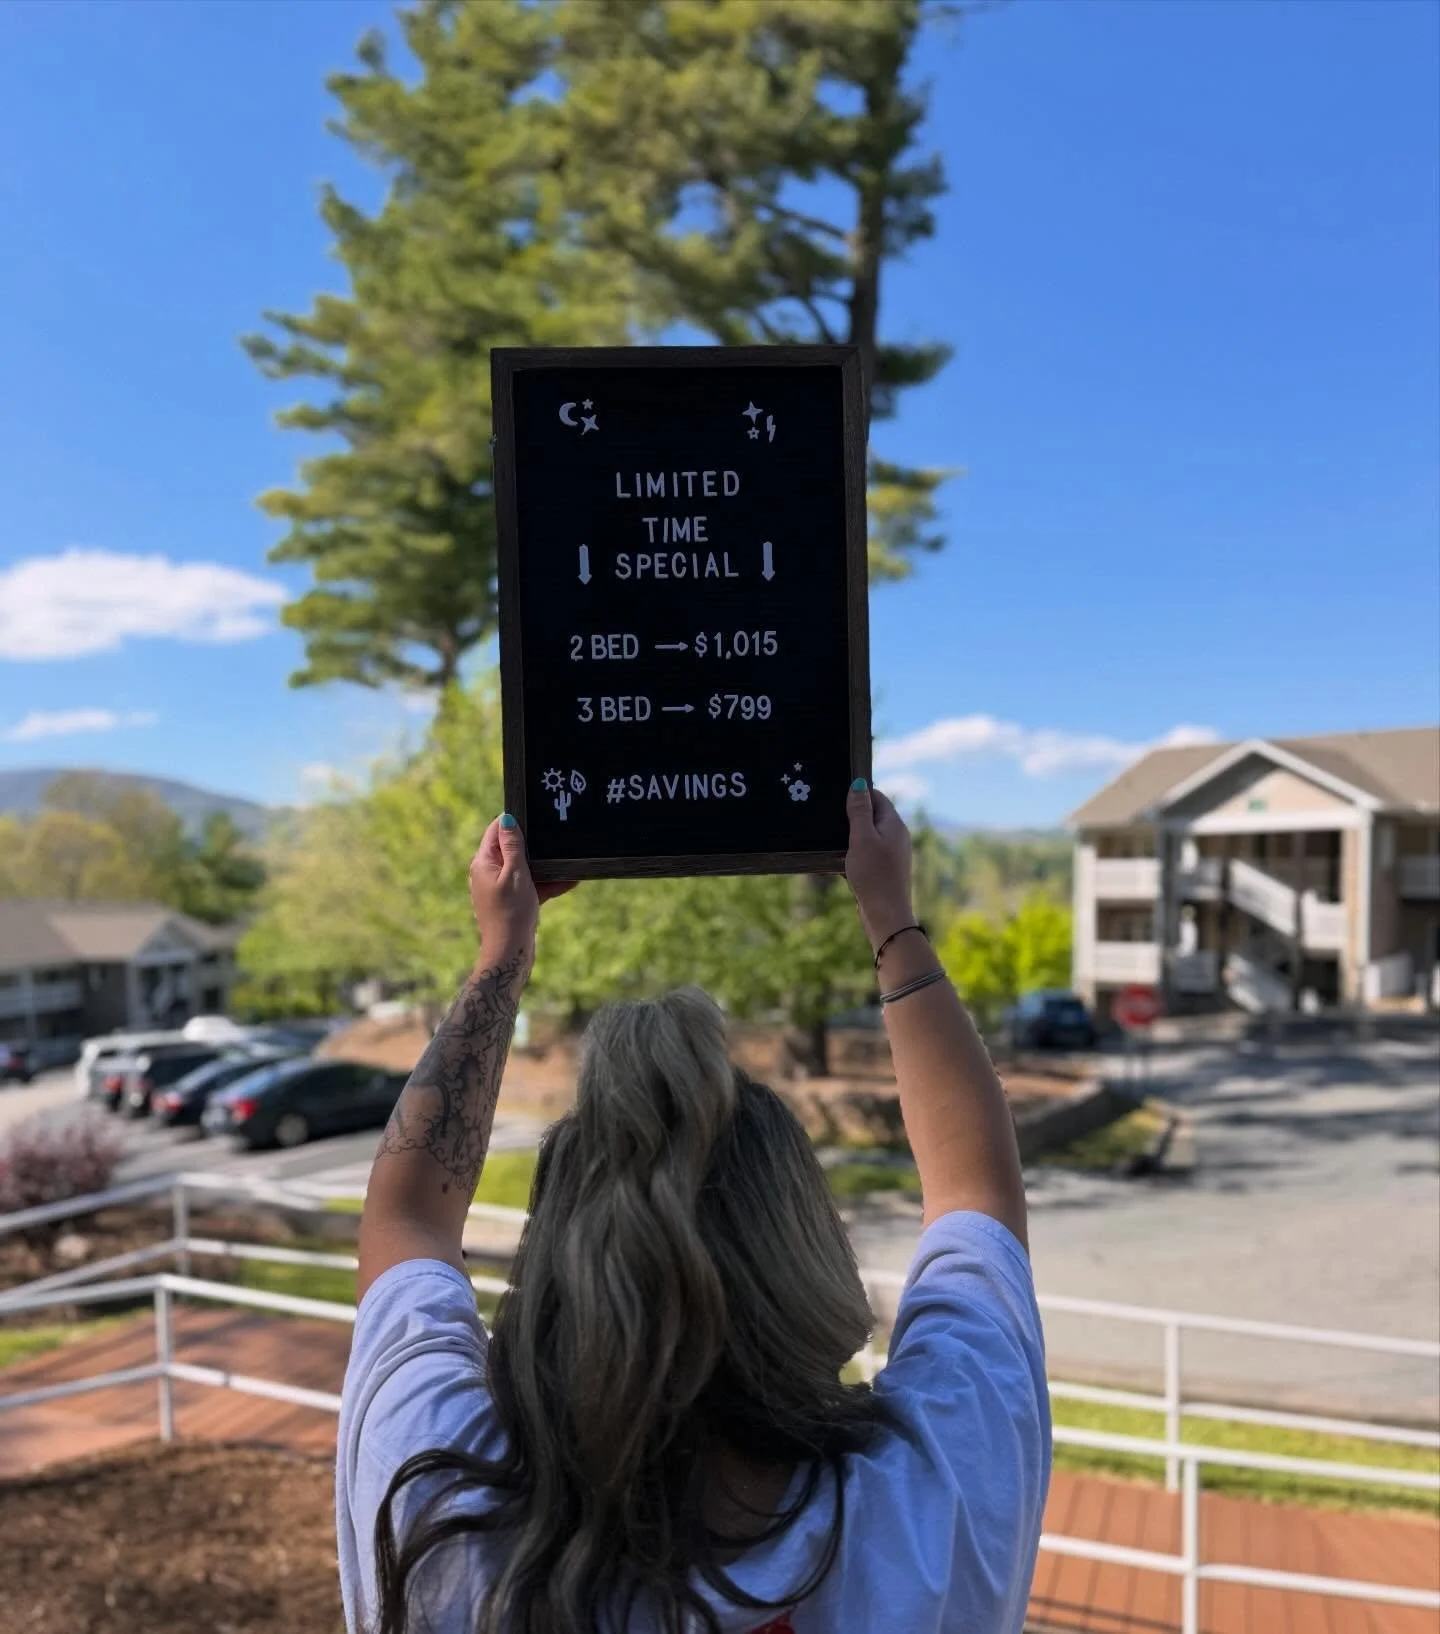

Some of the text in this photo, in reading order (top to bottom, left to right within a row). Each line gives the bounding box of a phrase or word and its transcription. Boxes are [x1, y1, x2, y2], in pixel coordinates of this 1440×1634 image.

[616, 470, 741, 498] LIMITED
[643, 516, 708, 543] TIME
[615, 551, 739, 579] SPECIAL
[570, 630, 778, 660] 2 BED $1,015
[578, 693, 771, 722] 3 BED $799
[606, 771, 747, 803] #SAVINGS
